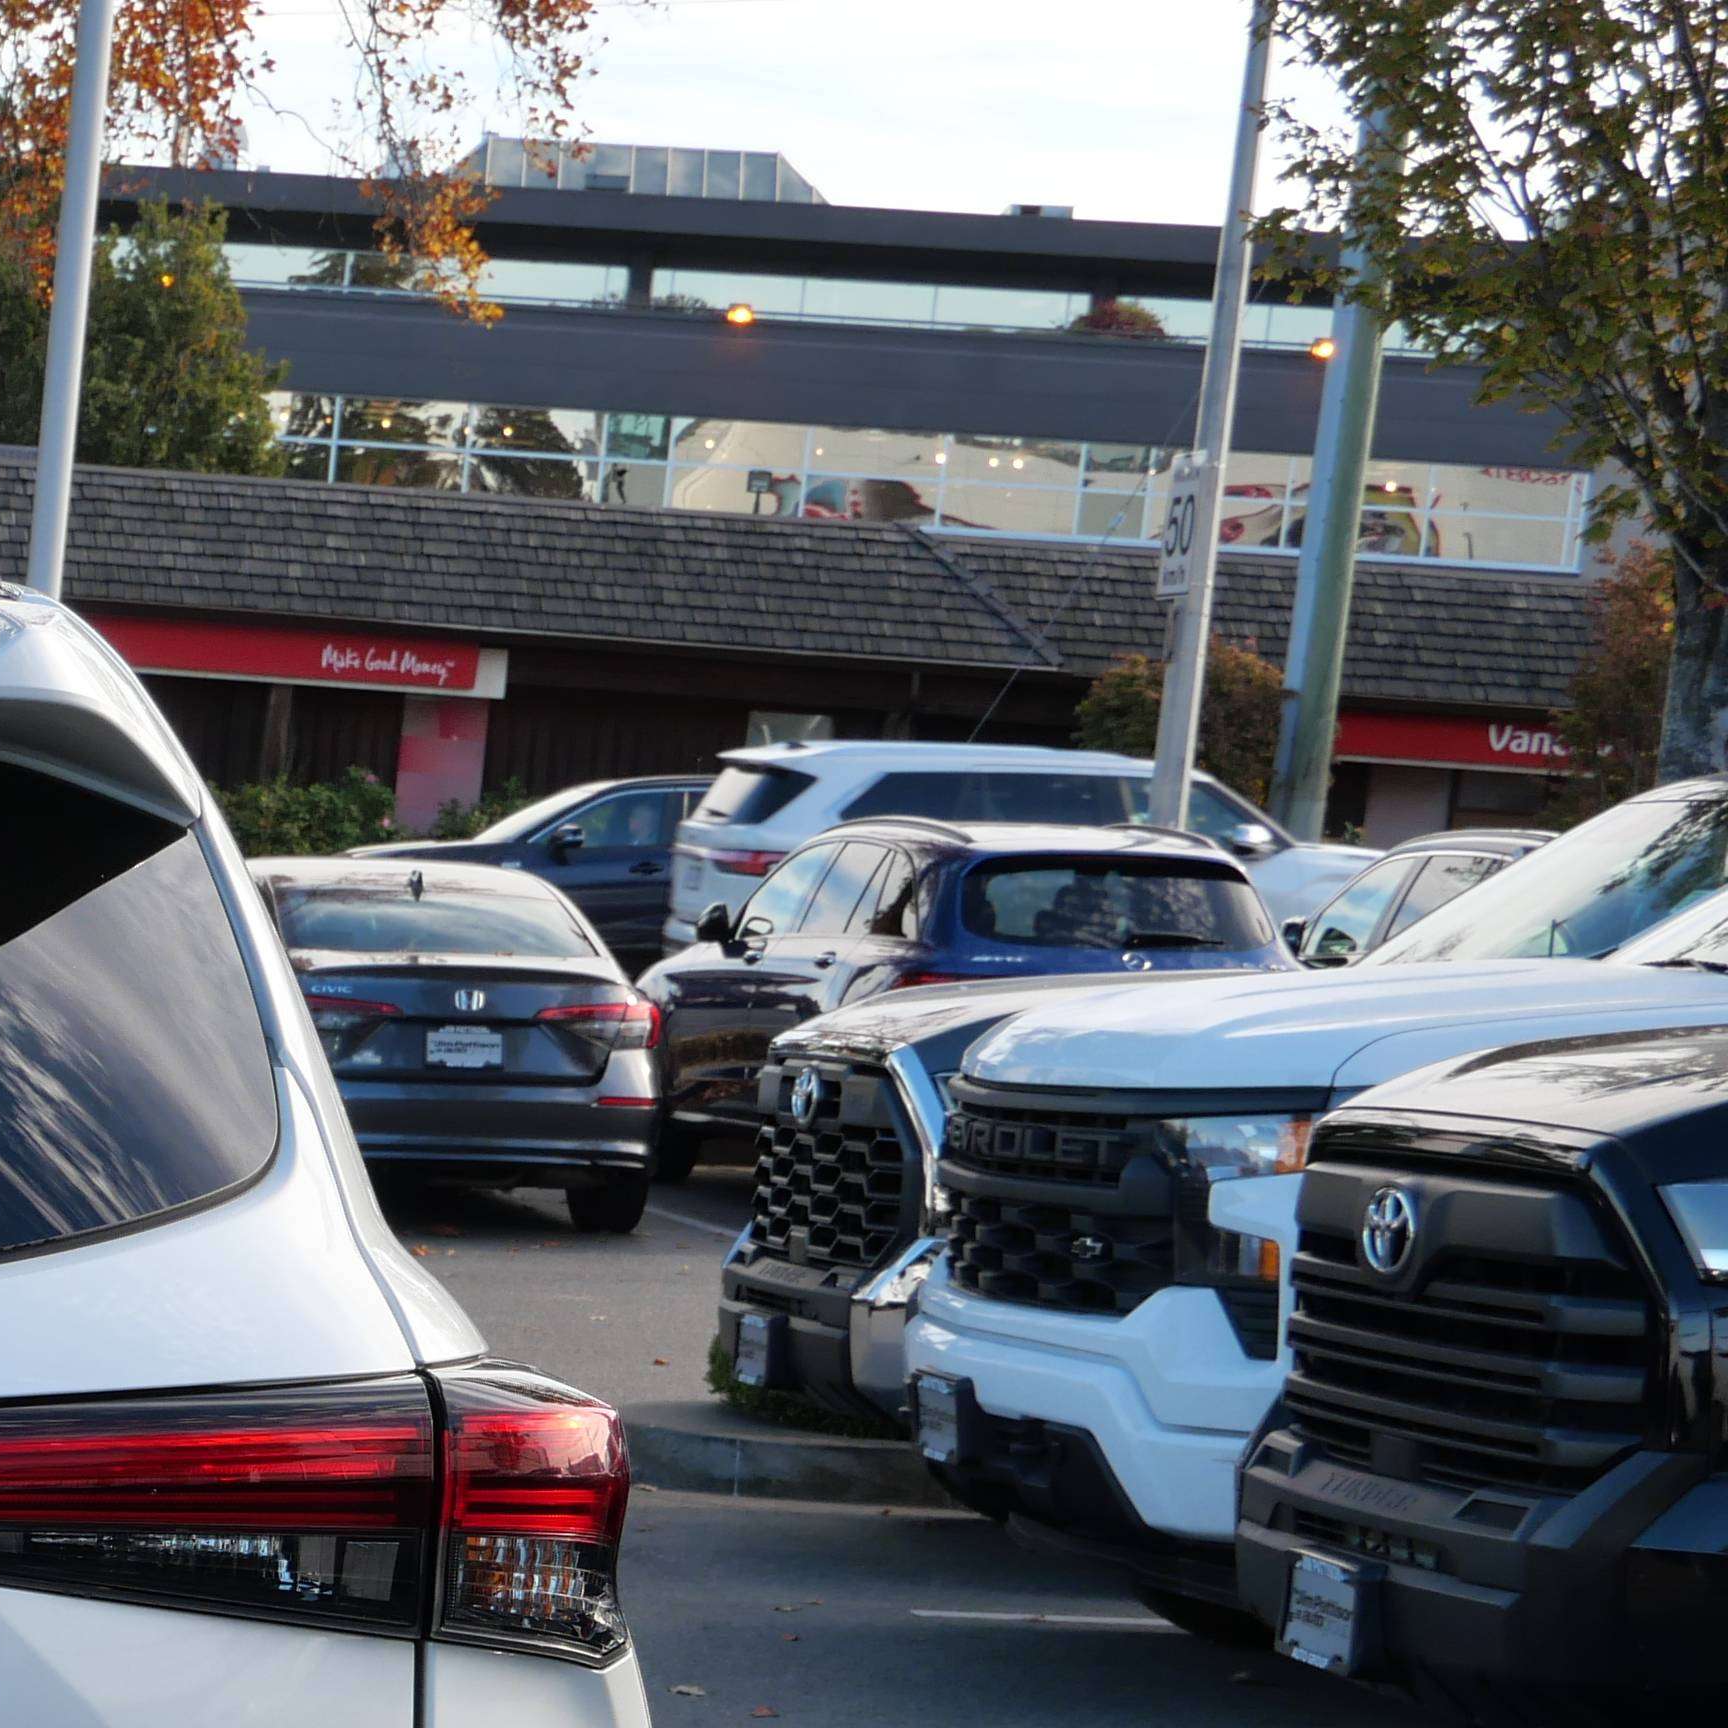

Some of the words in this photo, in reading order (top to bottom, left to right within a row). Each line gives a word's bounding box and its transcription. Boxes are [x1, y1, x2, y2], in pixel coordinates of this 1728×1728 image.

[1164, 493, 1195, 557] 50
[365, 646, 396, 672] Good
[311, 985, 353, 994] CIVIC
